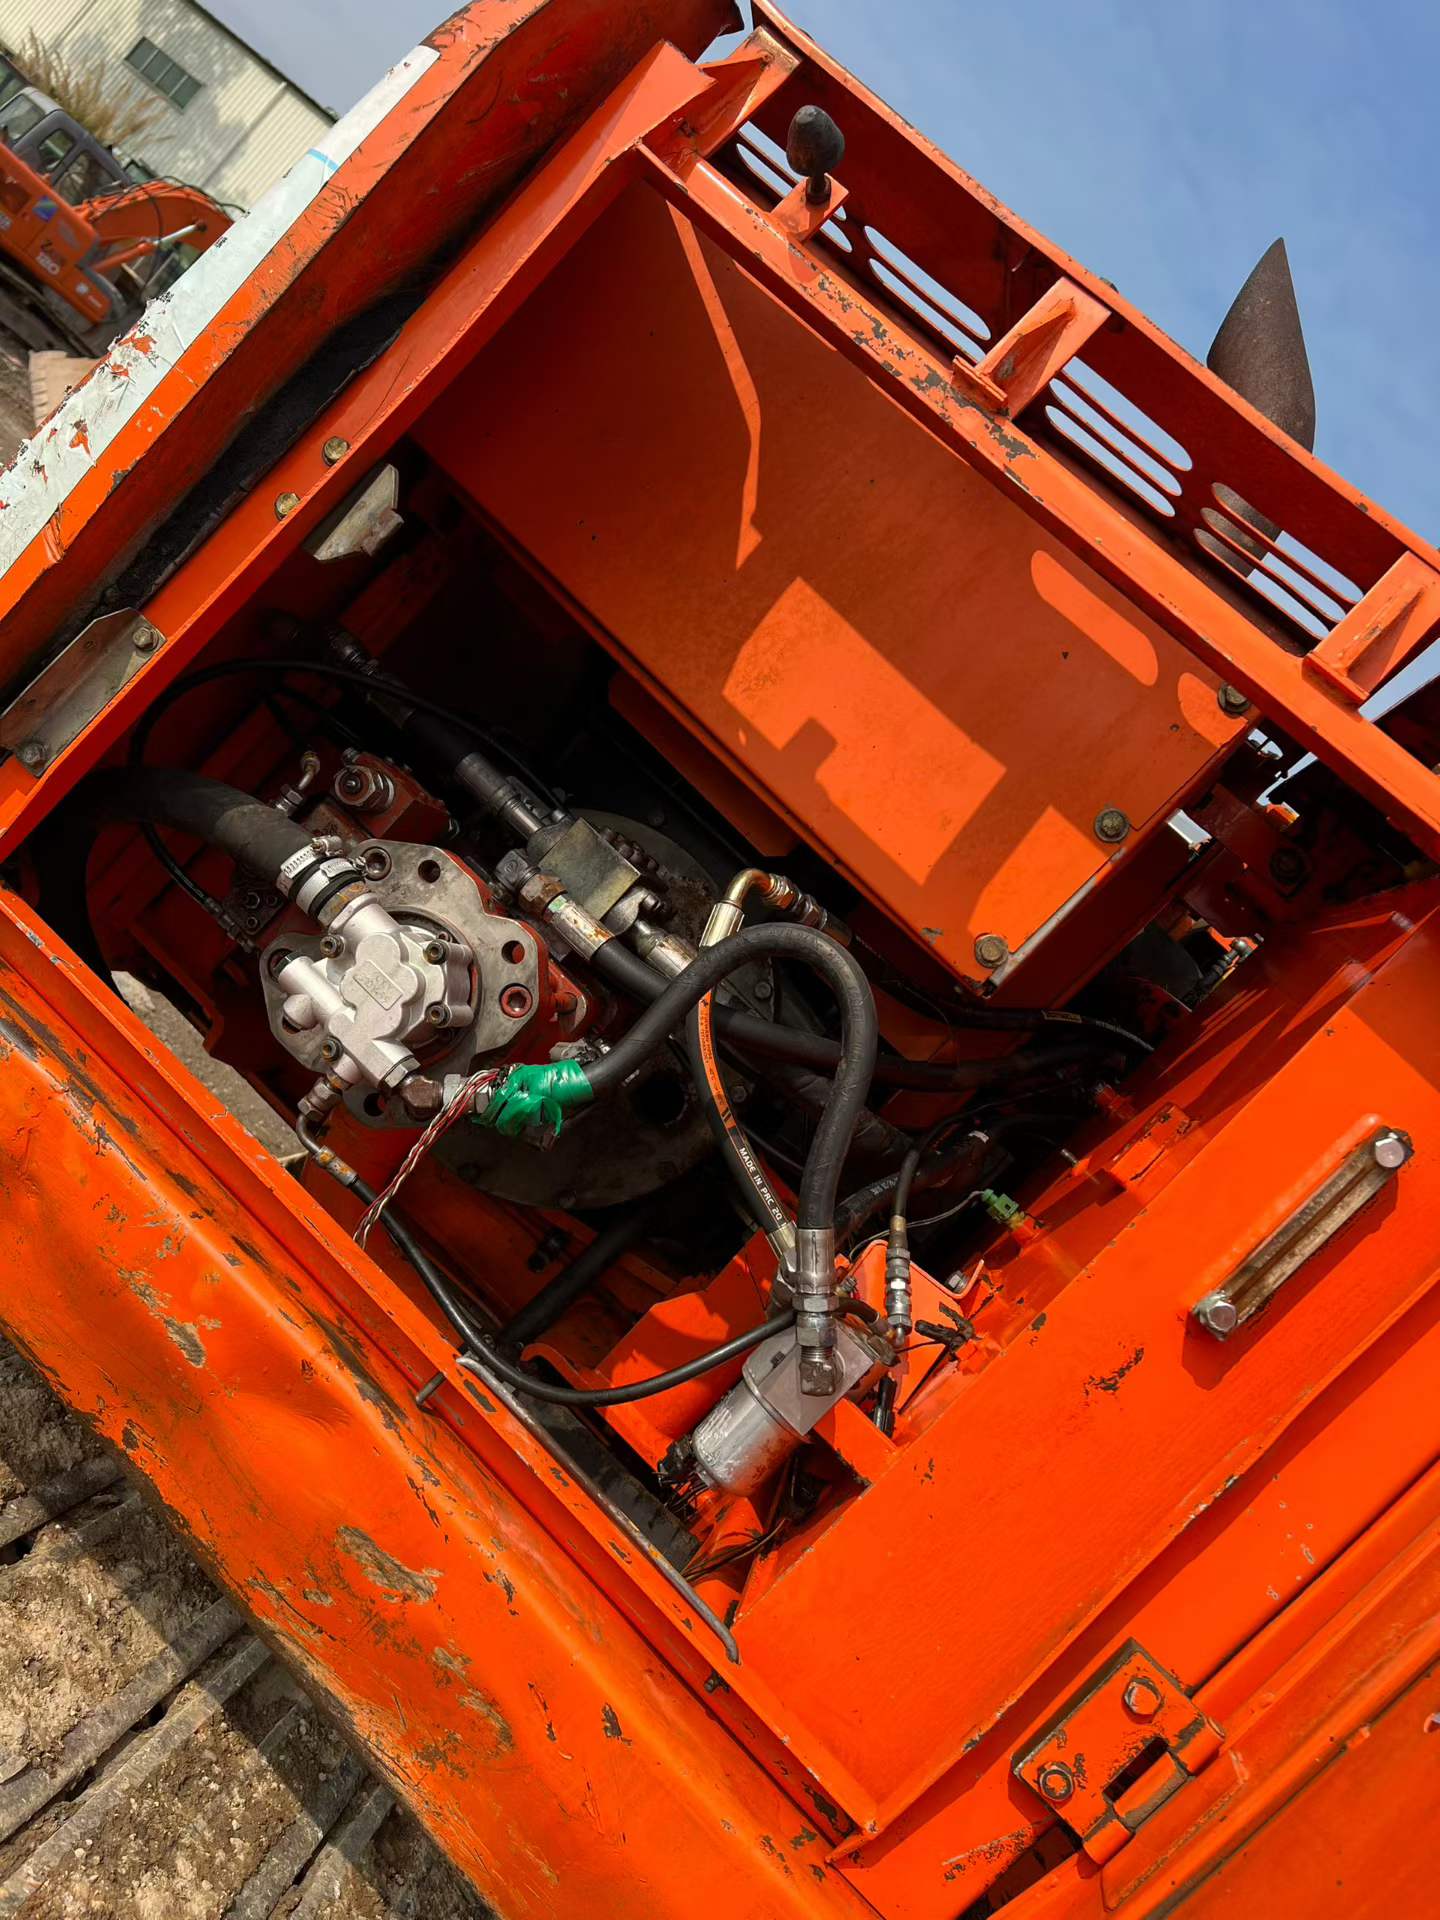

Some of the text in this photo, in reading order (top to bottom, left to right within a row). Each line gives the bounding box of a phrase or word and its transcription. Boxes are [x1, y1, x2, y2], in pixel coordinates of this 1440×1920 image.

[739, 1147, 756, 1173] MADE
[753, 1175, 763, 1186] IN
[760, 1187, 774, 1206] PRC
